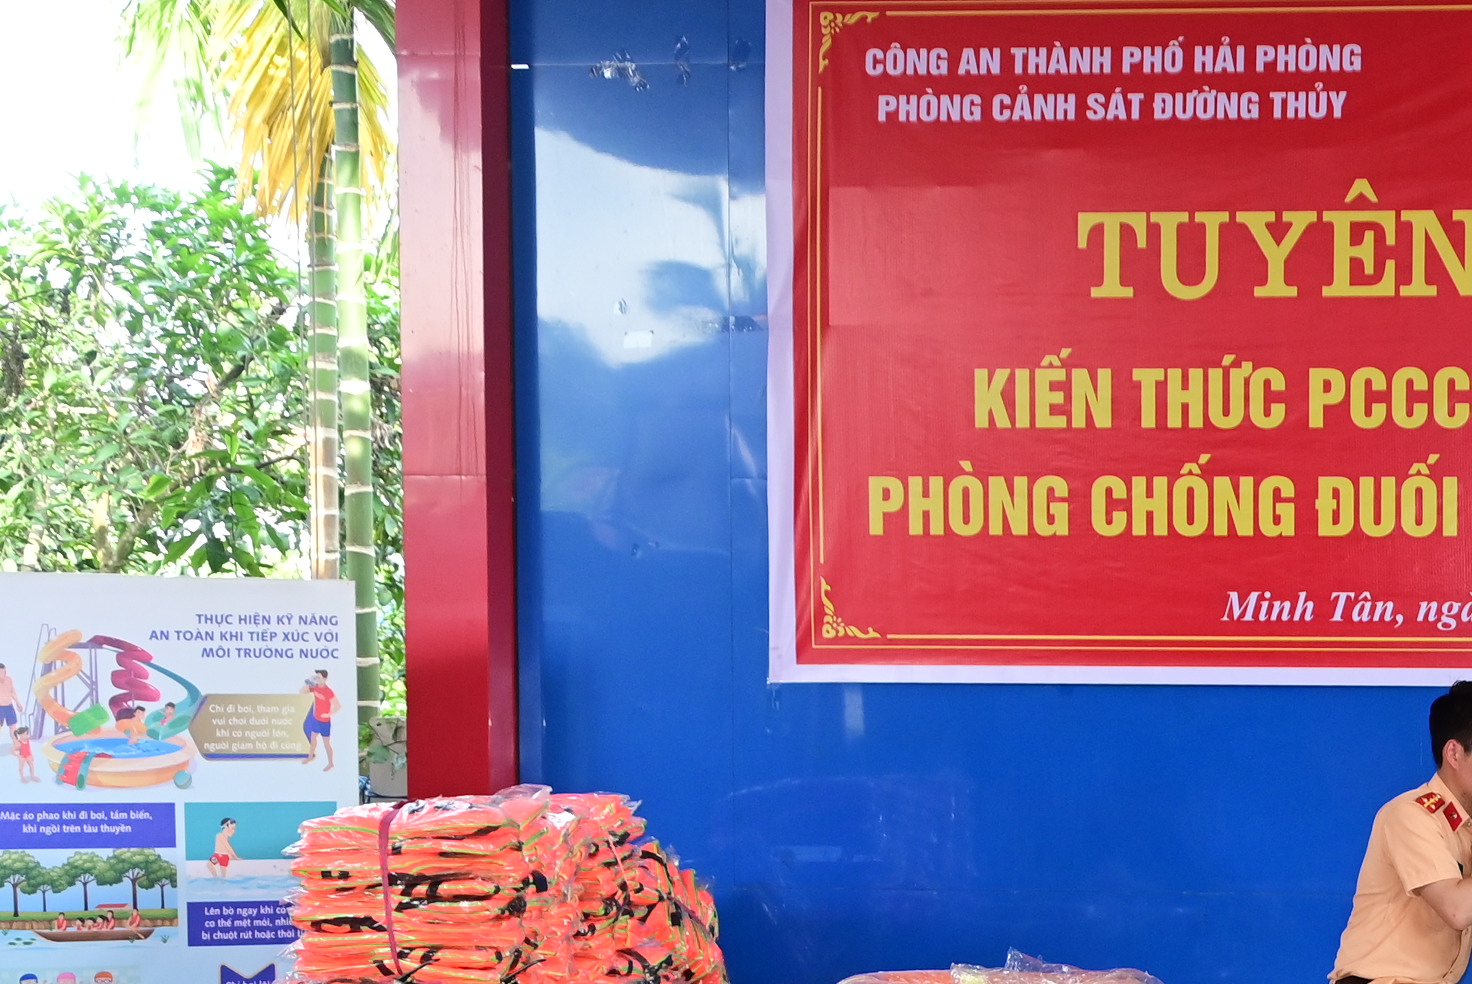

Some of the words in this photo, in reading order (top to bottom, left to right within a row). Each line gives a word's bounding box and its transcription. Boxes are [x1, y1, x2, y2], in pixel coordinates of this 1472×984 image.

[865, 42, 948, 75] CÔNG
[958, 48, 1000, 74] AN
[1011, 41, 1112, 74] THÀNH
[1122, 36, 1184, 73] PHỐ
[1194, 36, 1244, 73] HẢI
[1256, 38, 1362, 72] PHÒNG
[878, 88, 981, 122] PHÒNG
[992, 85, 1076, 121] CẢNH
[1086, 87, 1144, 120] SÁT
[1153, 85, 1259, 119] ĐƯỜNG
[1270, 82, 1346, 119] THỦY
[974, 348, 1111, 429] KIẾN
[1133, 354, 1286, 430] THỨC
[1308, 366, 1471, 430] PCCC
[867, 460, 1069, 537] PHÒNG
[1091, 453, 1295, 537] CHỐNG
[1315, 453, 1458, 537] ĐUỐI
[1221, 591, 1314, 623] Minh
[1329, 592, 1404, 628] Tân,
